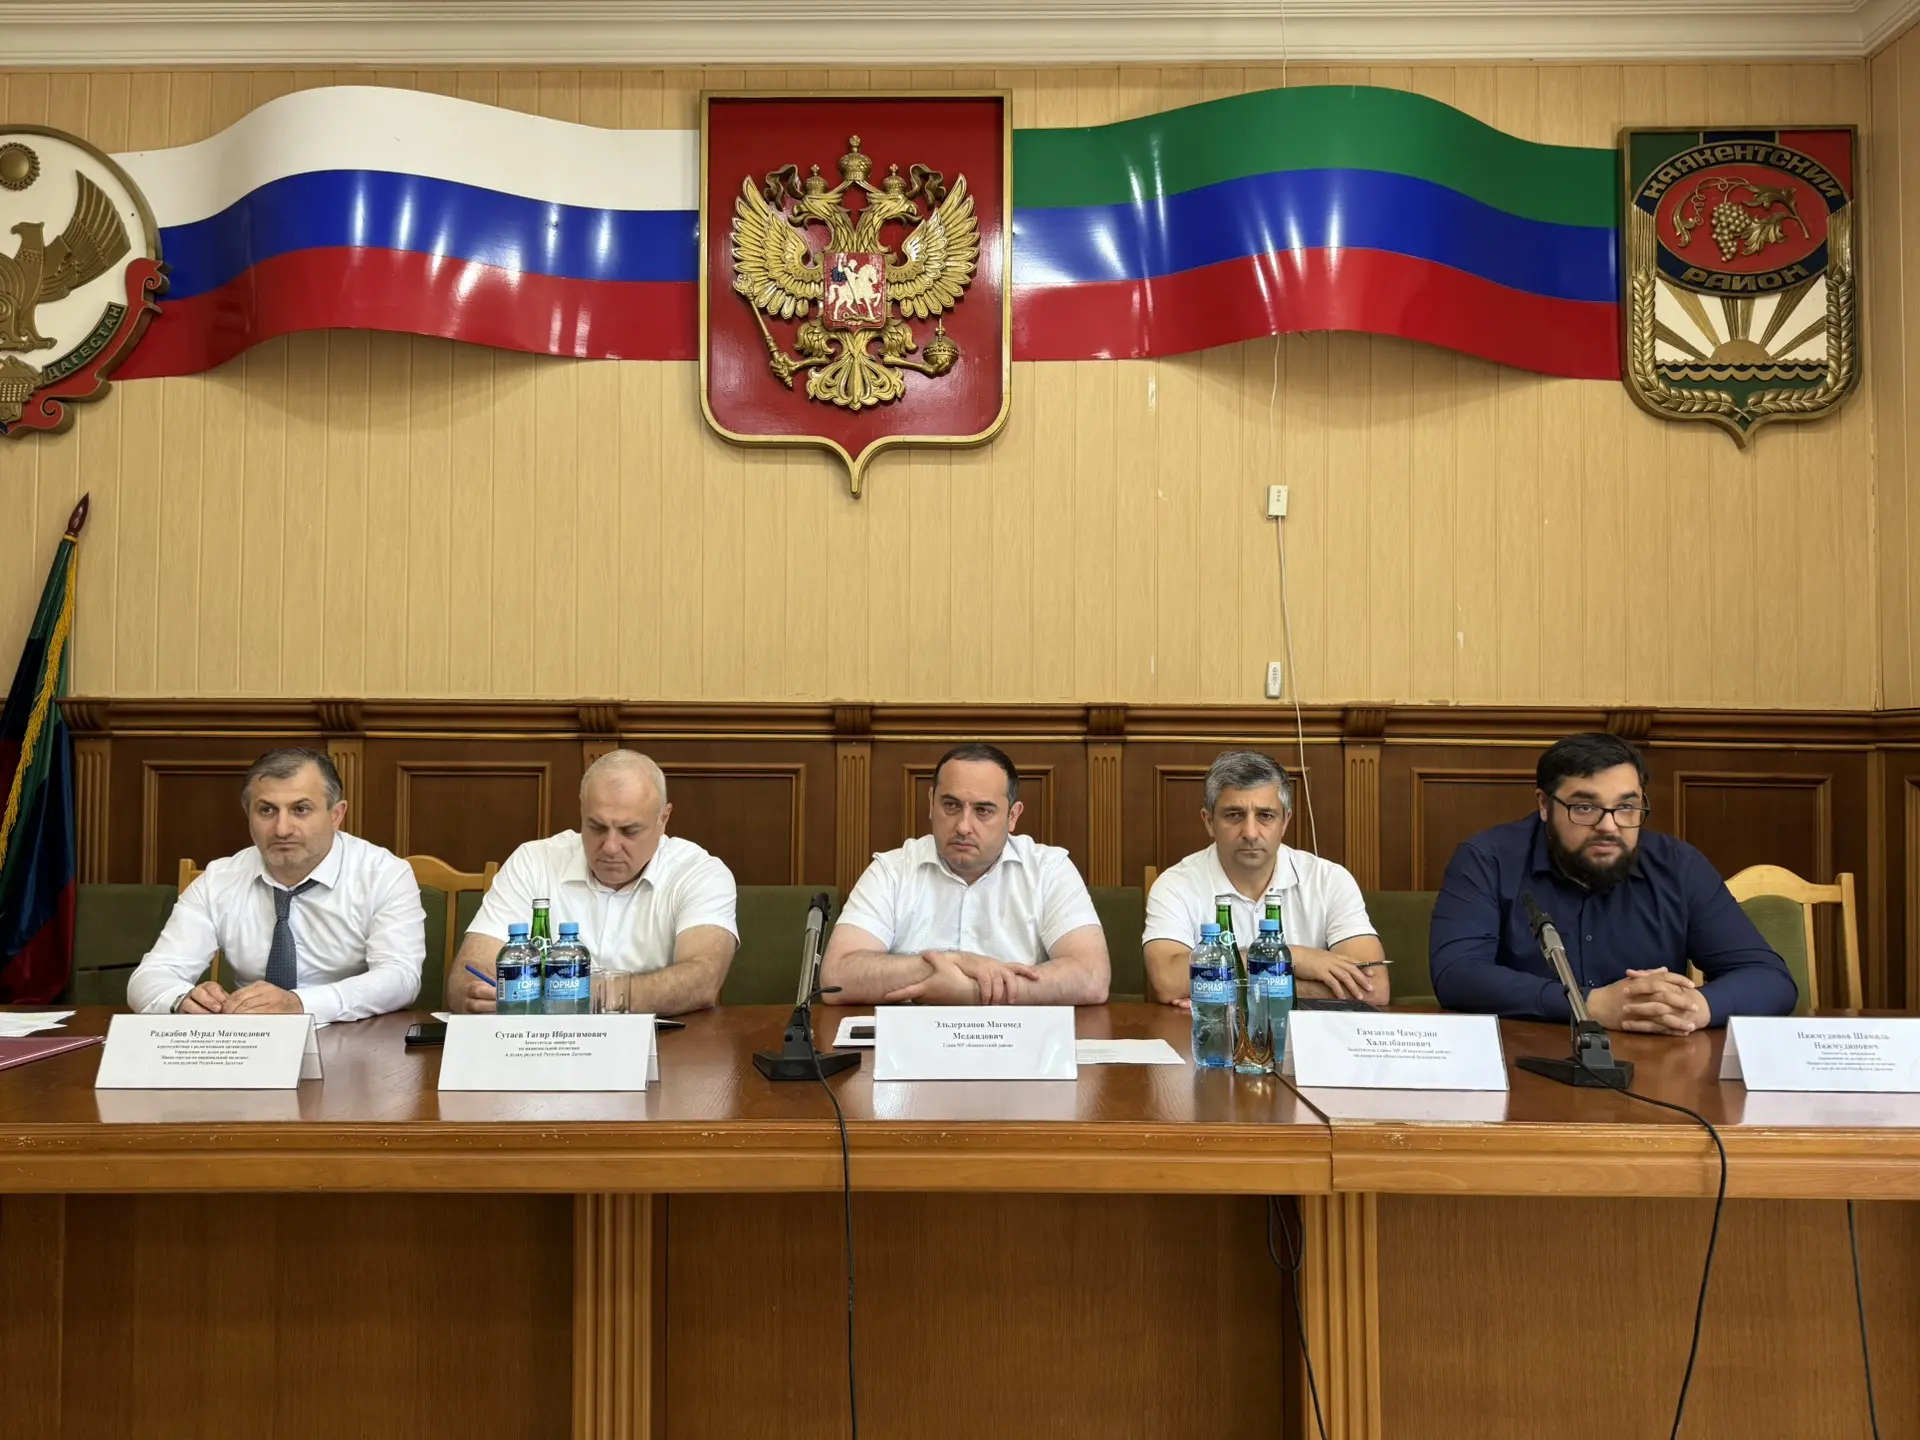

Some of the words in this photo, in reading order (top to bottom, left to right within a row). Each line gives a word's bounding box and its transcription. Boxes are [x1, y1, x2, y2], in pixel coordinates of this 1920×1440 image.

[47, 305, 123, 380] ДАГЕСТАН
[550, 979, 580, 988] ГОРНАЯ
[1194, 982, 1223, 992] ГОРНАЯ
[934, 1020, 985, 1030] Эльдерханов
[987, 1020, 1022, 1028] Магомед
[150, 1029, 187, 1037] Раджабов
[190, 1030, 215, 1038] Мурад
[495, 1031, 523, 1040] Сутаев
[525, 1031, 550, 1039] Тагир
[552, 1030, 607, 1039] Ибрагимович
[1356, 1028, 1395, 1036] Гамзатов
